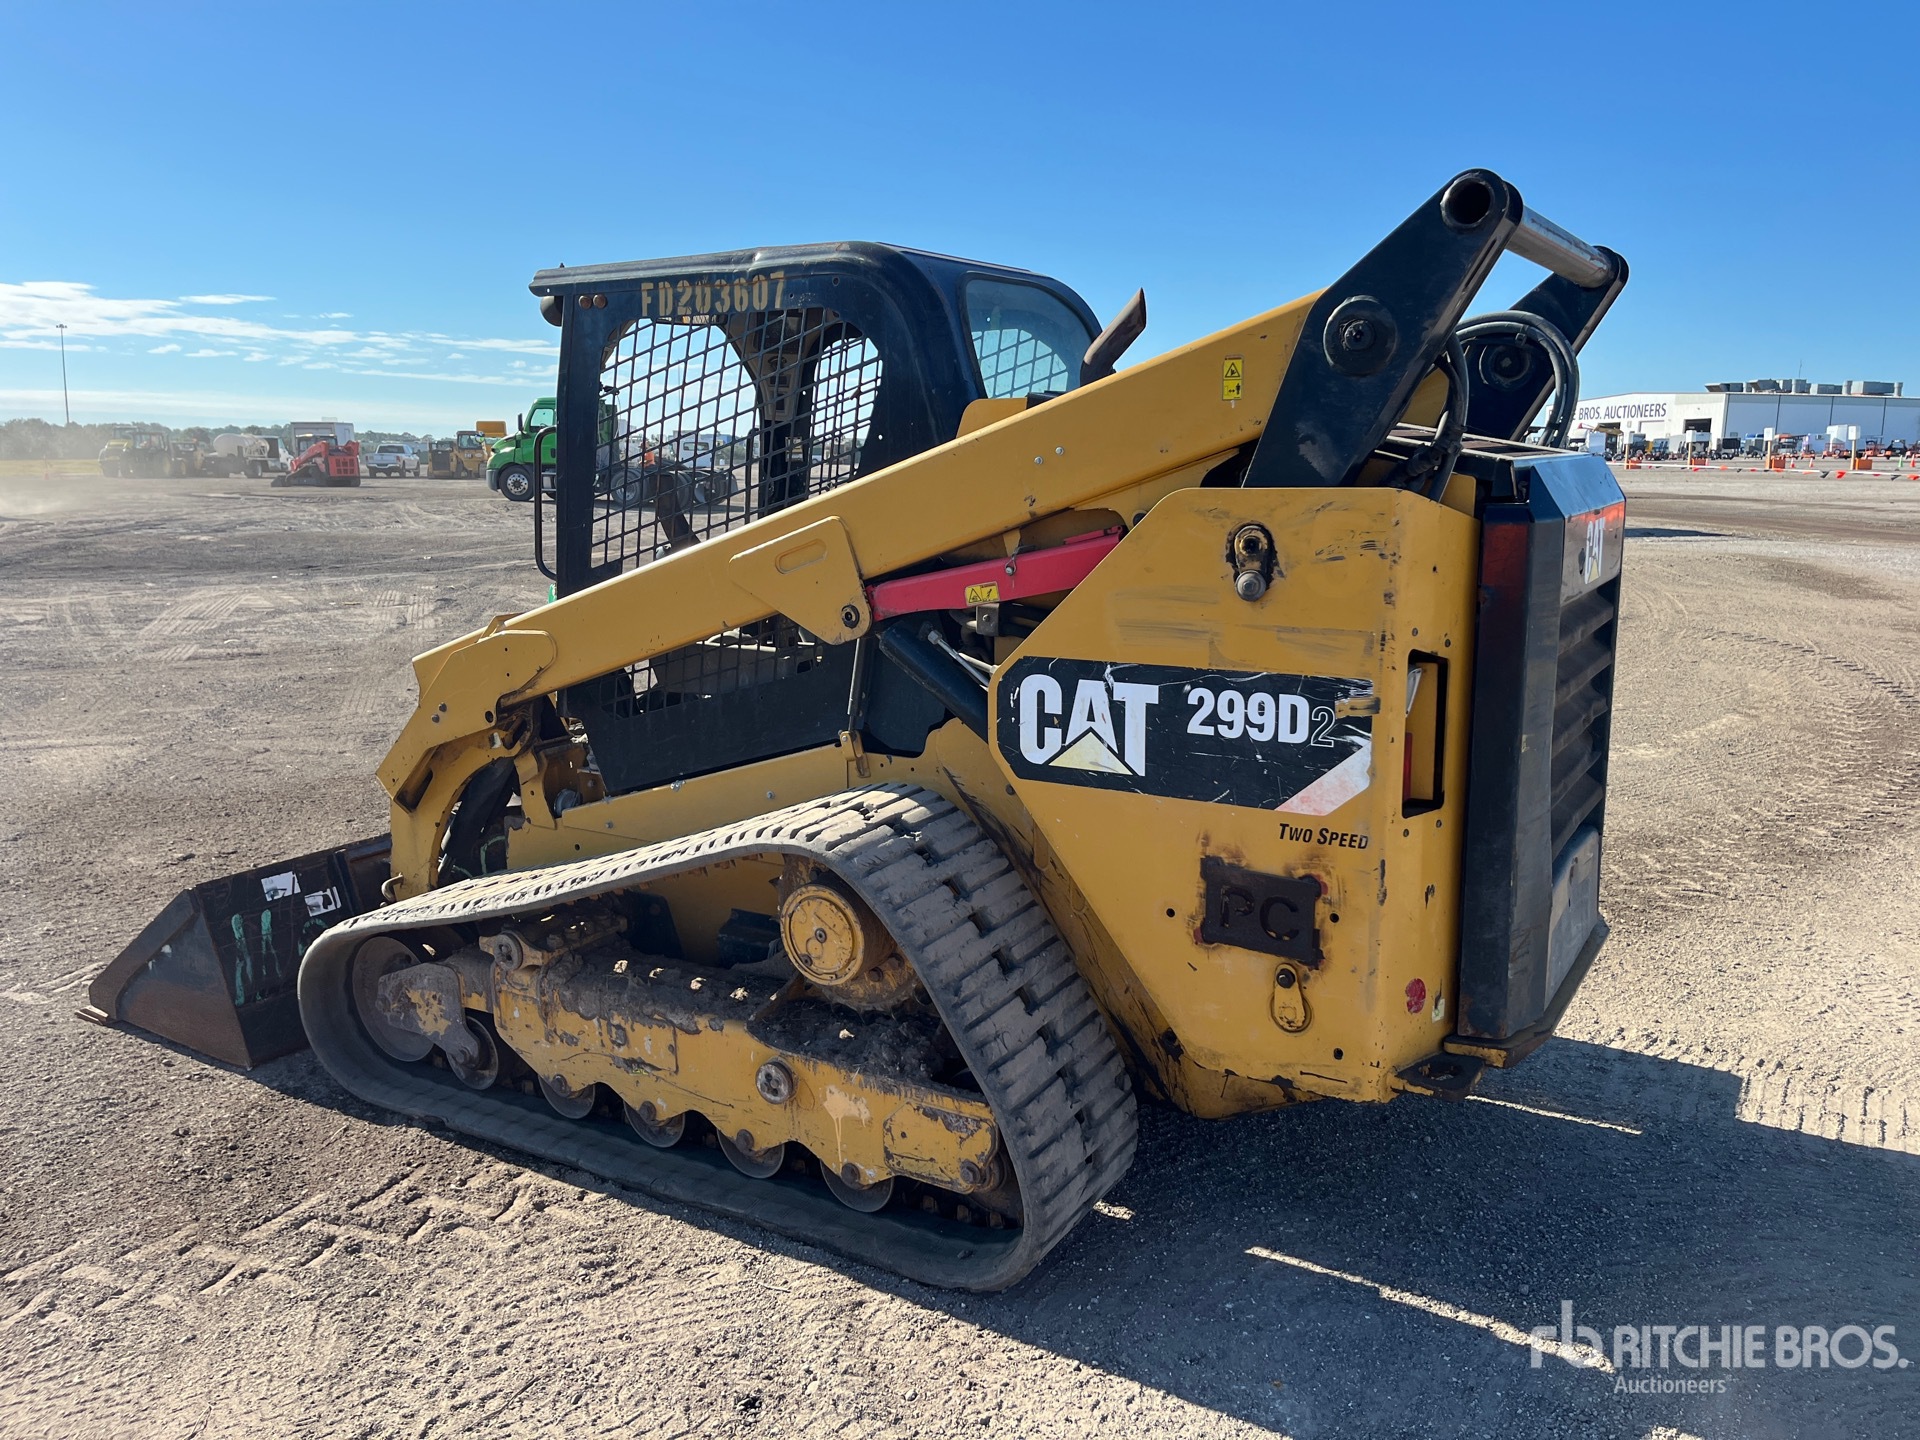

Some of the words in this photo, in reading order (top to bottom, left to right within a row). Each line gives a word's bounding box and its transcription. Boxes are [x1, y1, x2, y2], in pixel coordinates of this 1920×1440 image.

[641, 271, 785, 317] FD203607
[1579, 407, 1601, 420] BROS.
[1603, 403, 1667, 419] AUCTIONEERS
[1585, 517, 1605, 584] CAT
[1019, 674, 1159, 777] CAT
